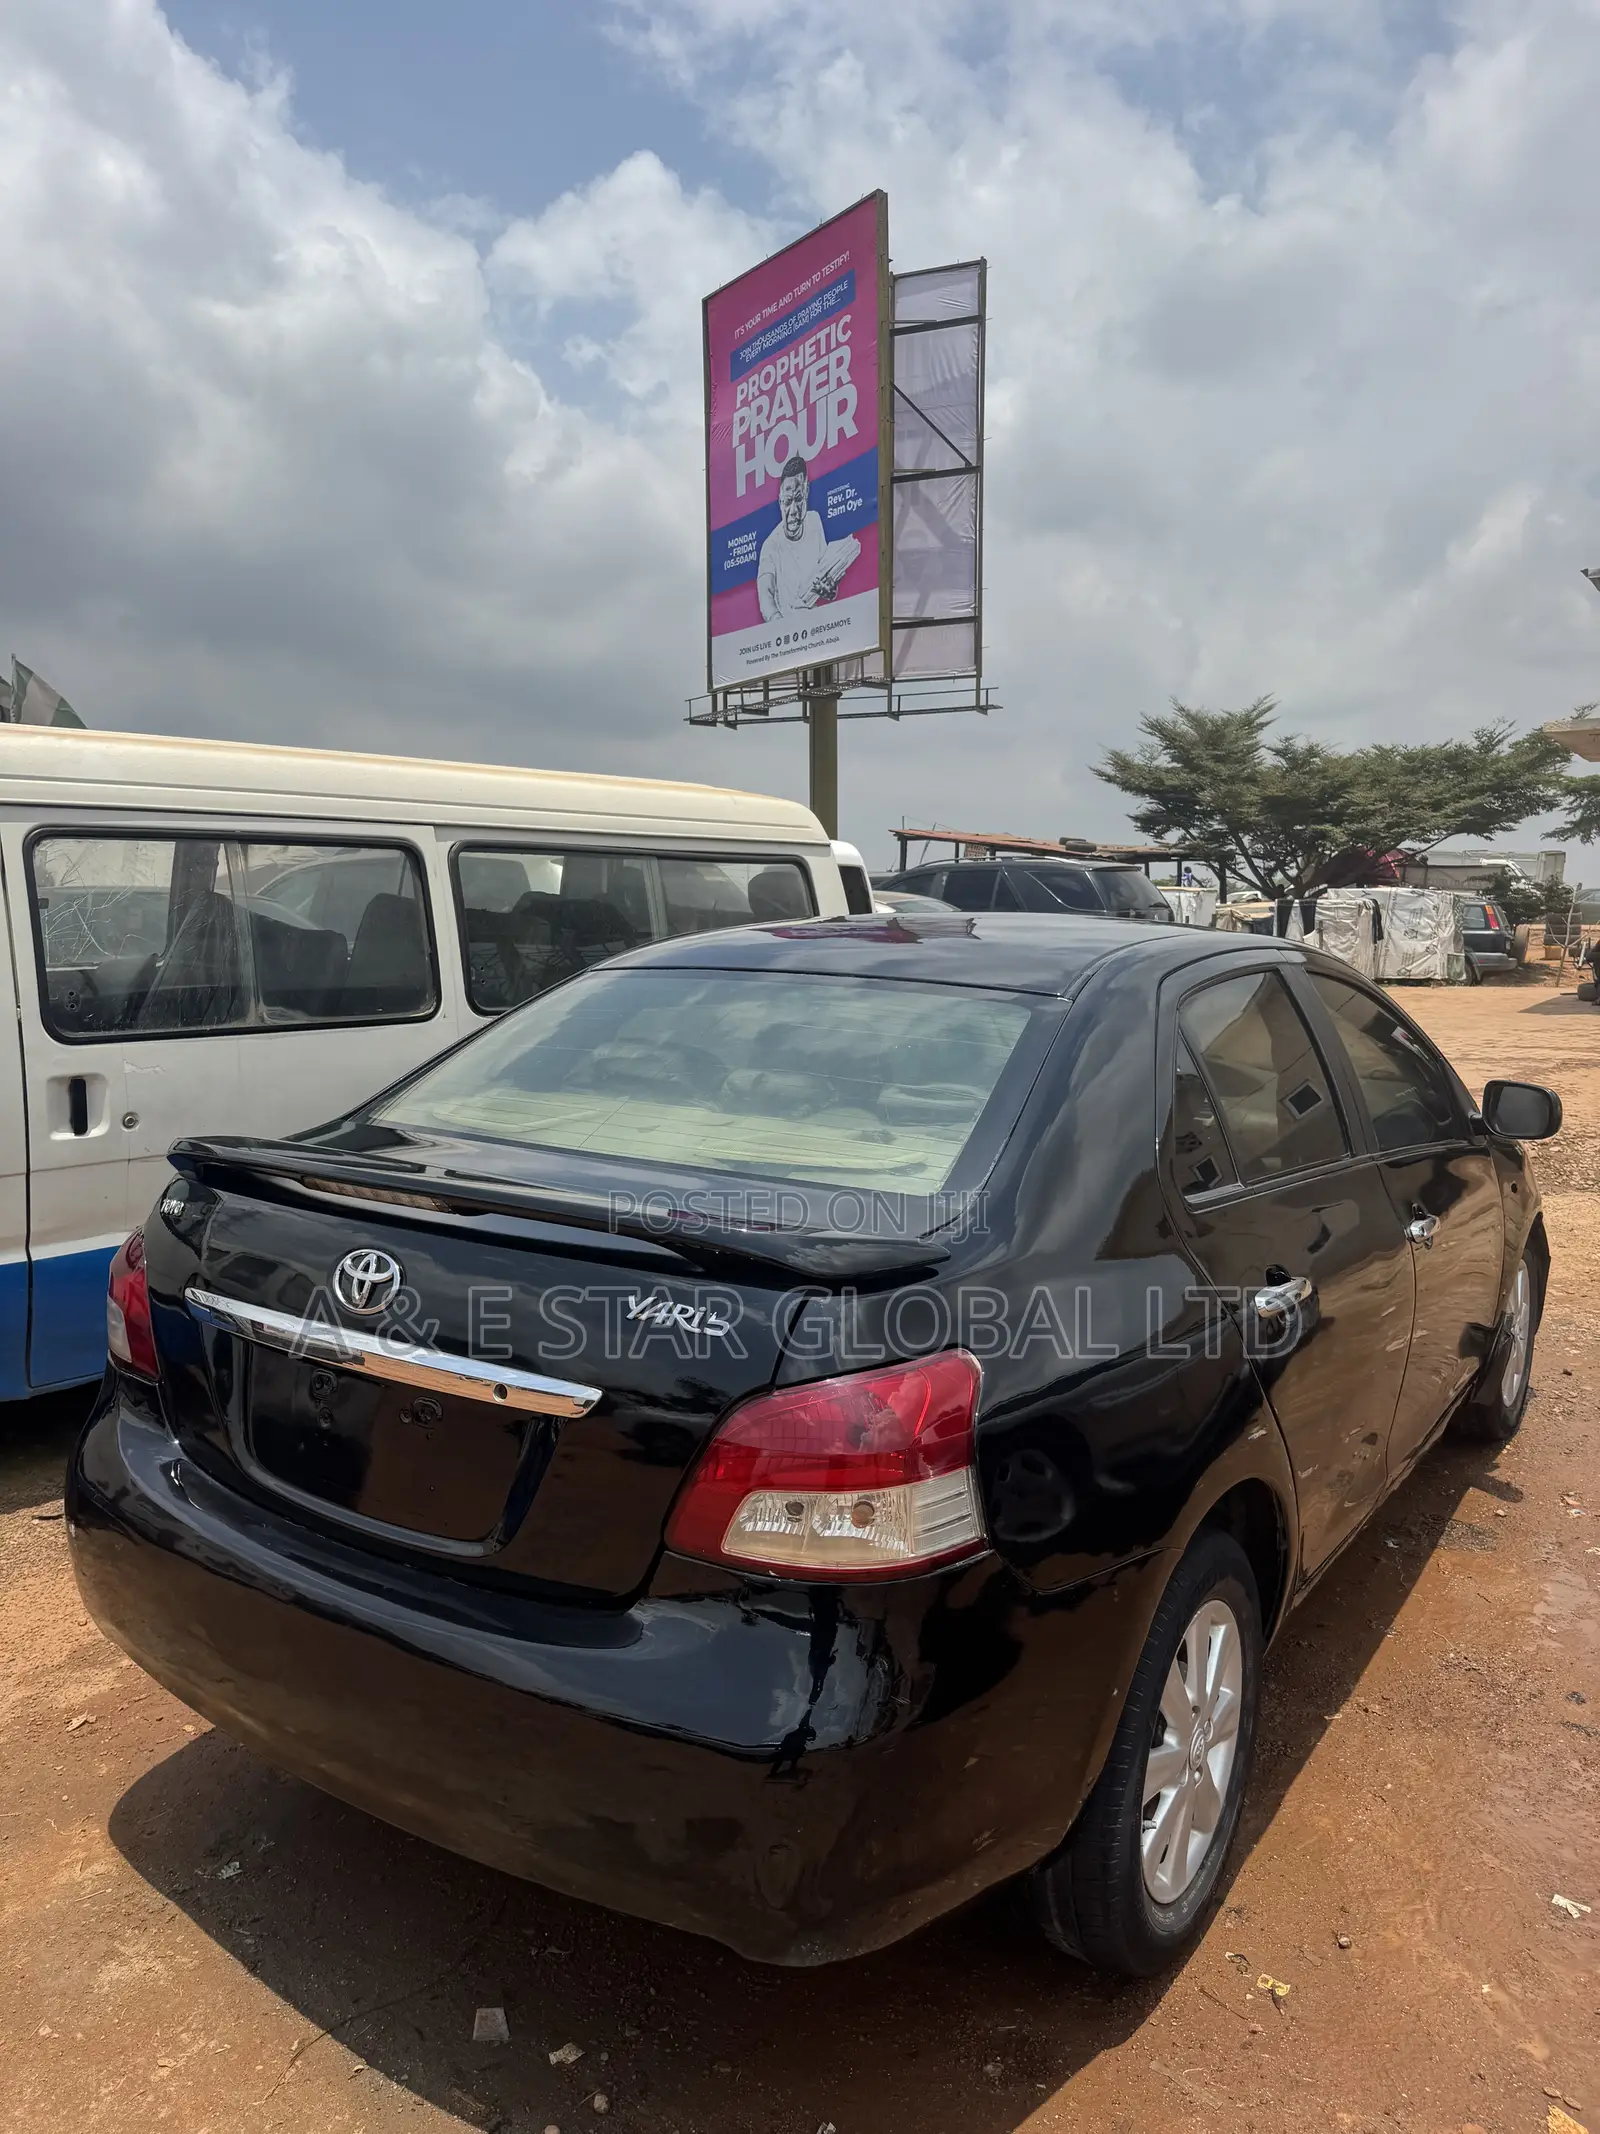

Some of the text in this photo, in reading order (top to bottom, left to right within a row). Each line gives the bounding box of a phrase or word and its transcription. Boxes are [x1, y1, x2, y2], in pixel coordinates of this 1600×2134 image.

[744, 313, 761, 331] YOUR
[761, 302, 778, 319] TIME
[778, 292, 793, 308] AND
[793, 281, 812, 298] TURN
[812, 272, 821, 284] TO
[821, 250, 850, 278] TESTIFY!
[739, 280, 849, 360] JOIN THOUSANDS OF PRAYING PEOPLE
[745, 346, 762, 363] EVERY
[762, 327, 792, 351] MORNING
[793, 315, 810, 333] (6AM)
[810, 306, 822, 320] FOR
[736, 314, 852, 409] PROPHETIC
[732, 345, 852, 448] PRAYER
[735, 383, 859, 498] HOUR
[827, 493, 845, 507] Rev.
[845, 488, 858, 500] Dr.
[827, 498, 863, 518] Sam Oye
[728, 530, 757, 549] MONDAY
[733, 541, 757, 557] FRIDAY
[739, 617, 852, 656] JOIN US LIVE @REVSAMOYE
[746, 657, 764, 665] Powered
[764, 654, 771, 662] By
[779, 645, 808, 657] Transforming
